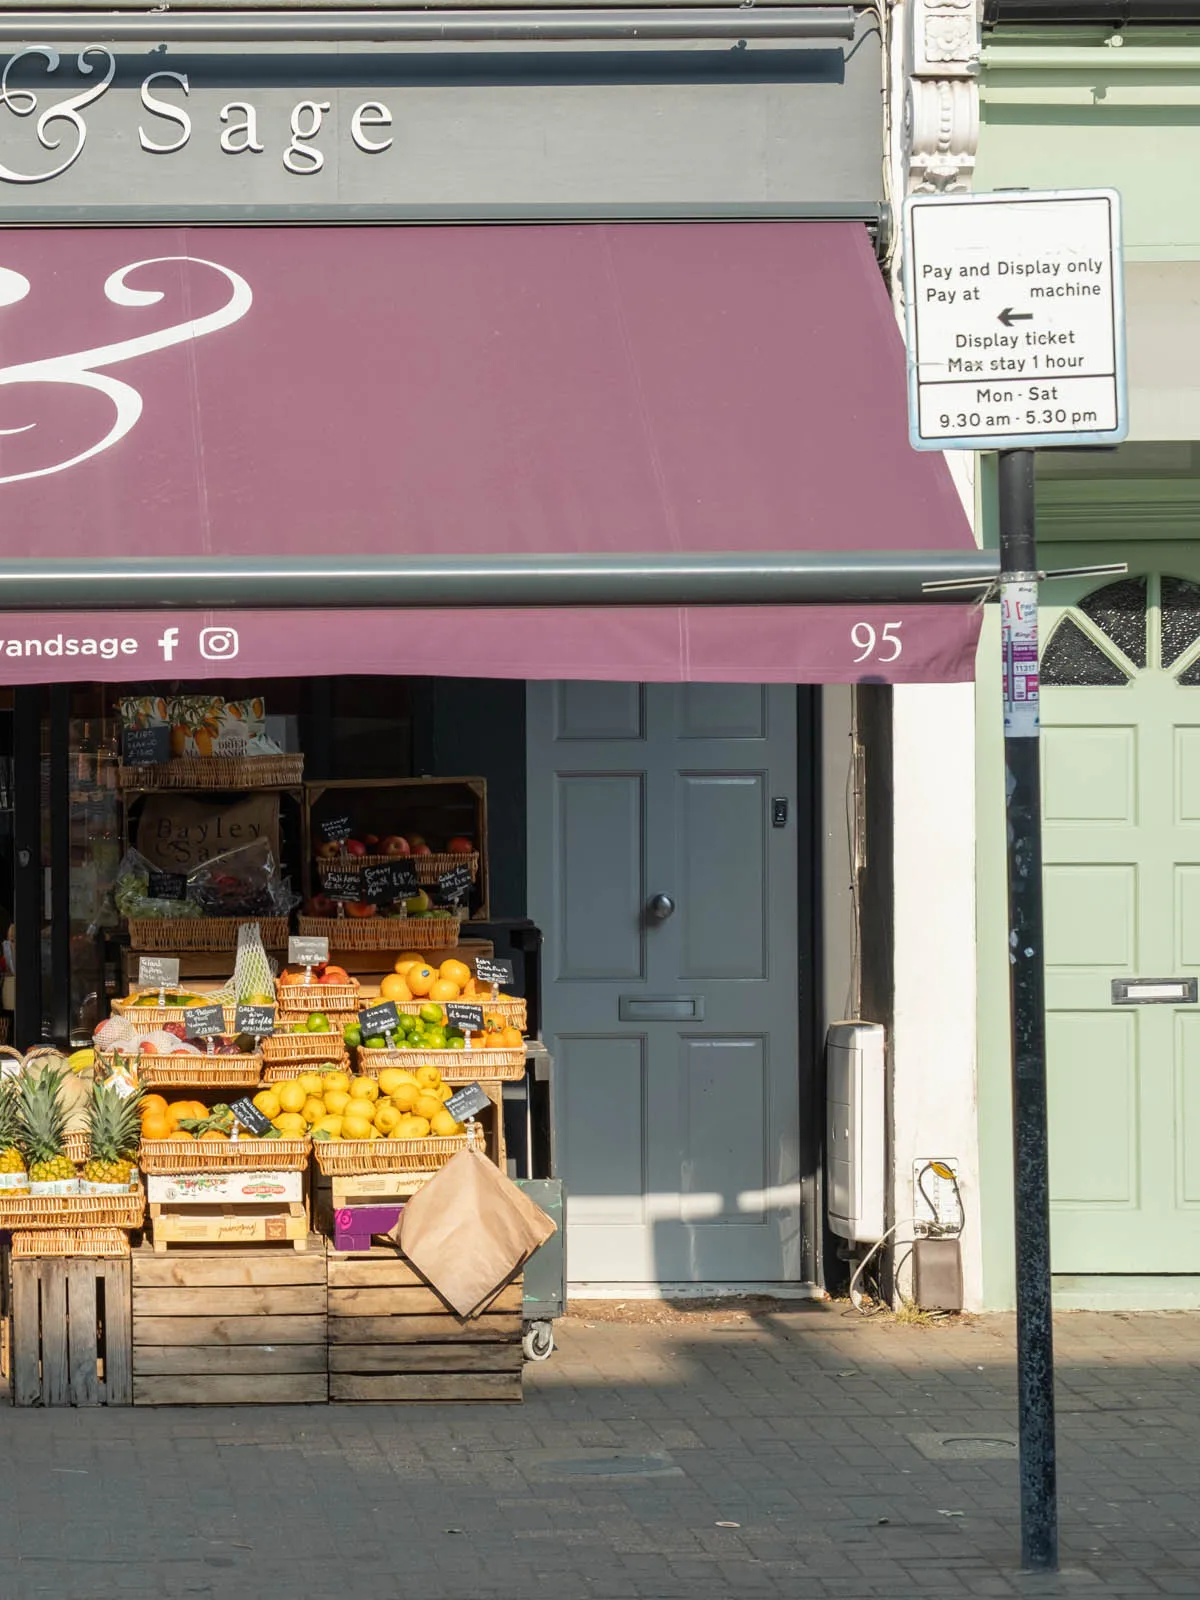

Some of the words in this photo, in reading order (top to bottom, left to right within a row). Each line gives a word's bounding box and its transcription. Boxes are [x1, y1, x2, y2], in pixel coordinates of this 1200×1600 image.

[137, 71, 395, 174] Sage
[922, 264, 953, 281] Pay
[959, 261, 991, 277] and
[997, 260, 1061, 279] Display
[1067, 257, 1103, 276] only
[926, 287, 956, 303] Pay
[963, 286, 981, 301] at
[1029, 282, 1102, 299] machine
[955, 332, 1019, 350] Display
[1025, 330, 1076, 345] ticket
[947, 357, 984, 373] Max
[990, 356, 1026, 373] stay
[1032, 355, 1039, 370] 1
[1045, 354, 1086, 369] hour
[976, 388, 1014, 404] Mon
[1028, 386, 1059, 401] Sat
[939, 412, 981, 428] 9.30
[986, 415, 1011, 426] am
[1025, 409, 1067, 425] 5.30
[1071, 411, 1098, 426] pm
[850, 620, 903, 663] 95
[157, 817, 261, 844] Bayley
